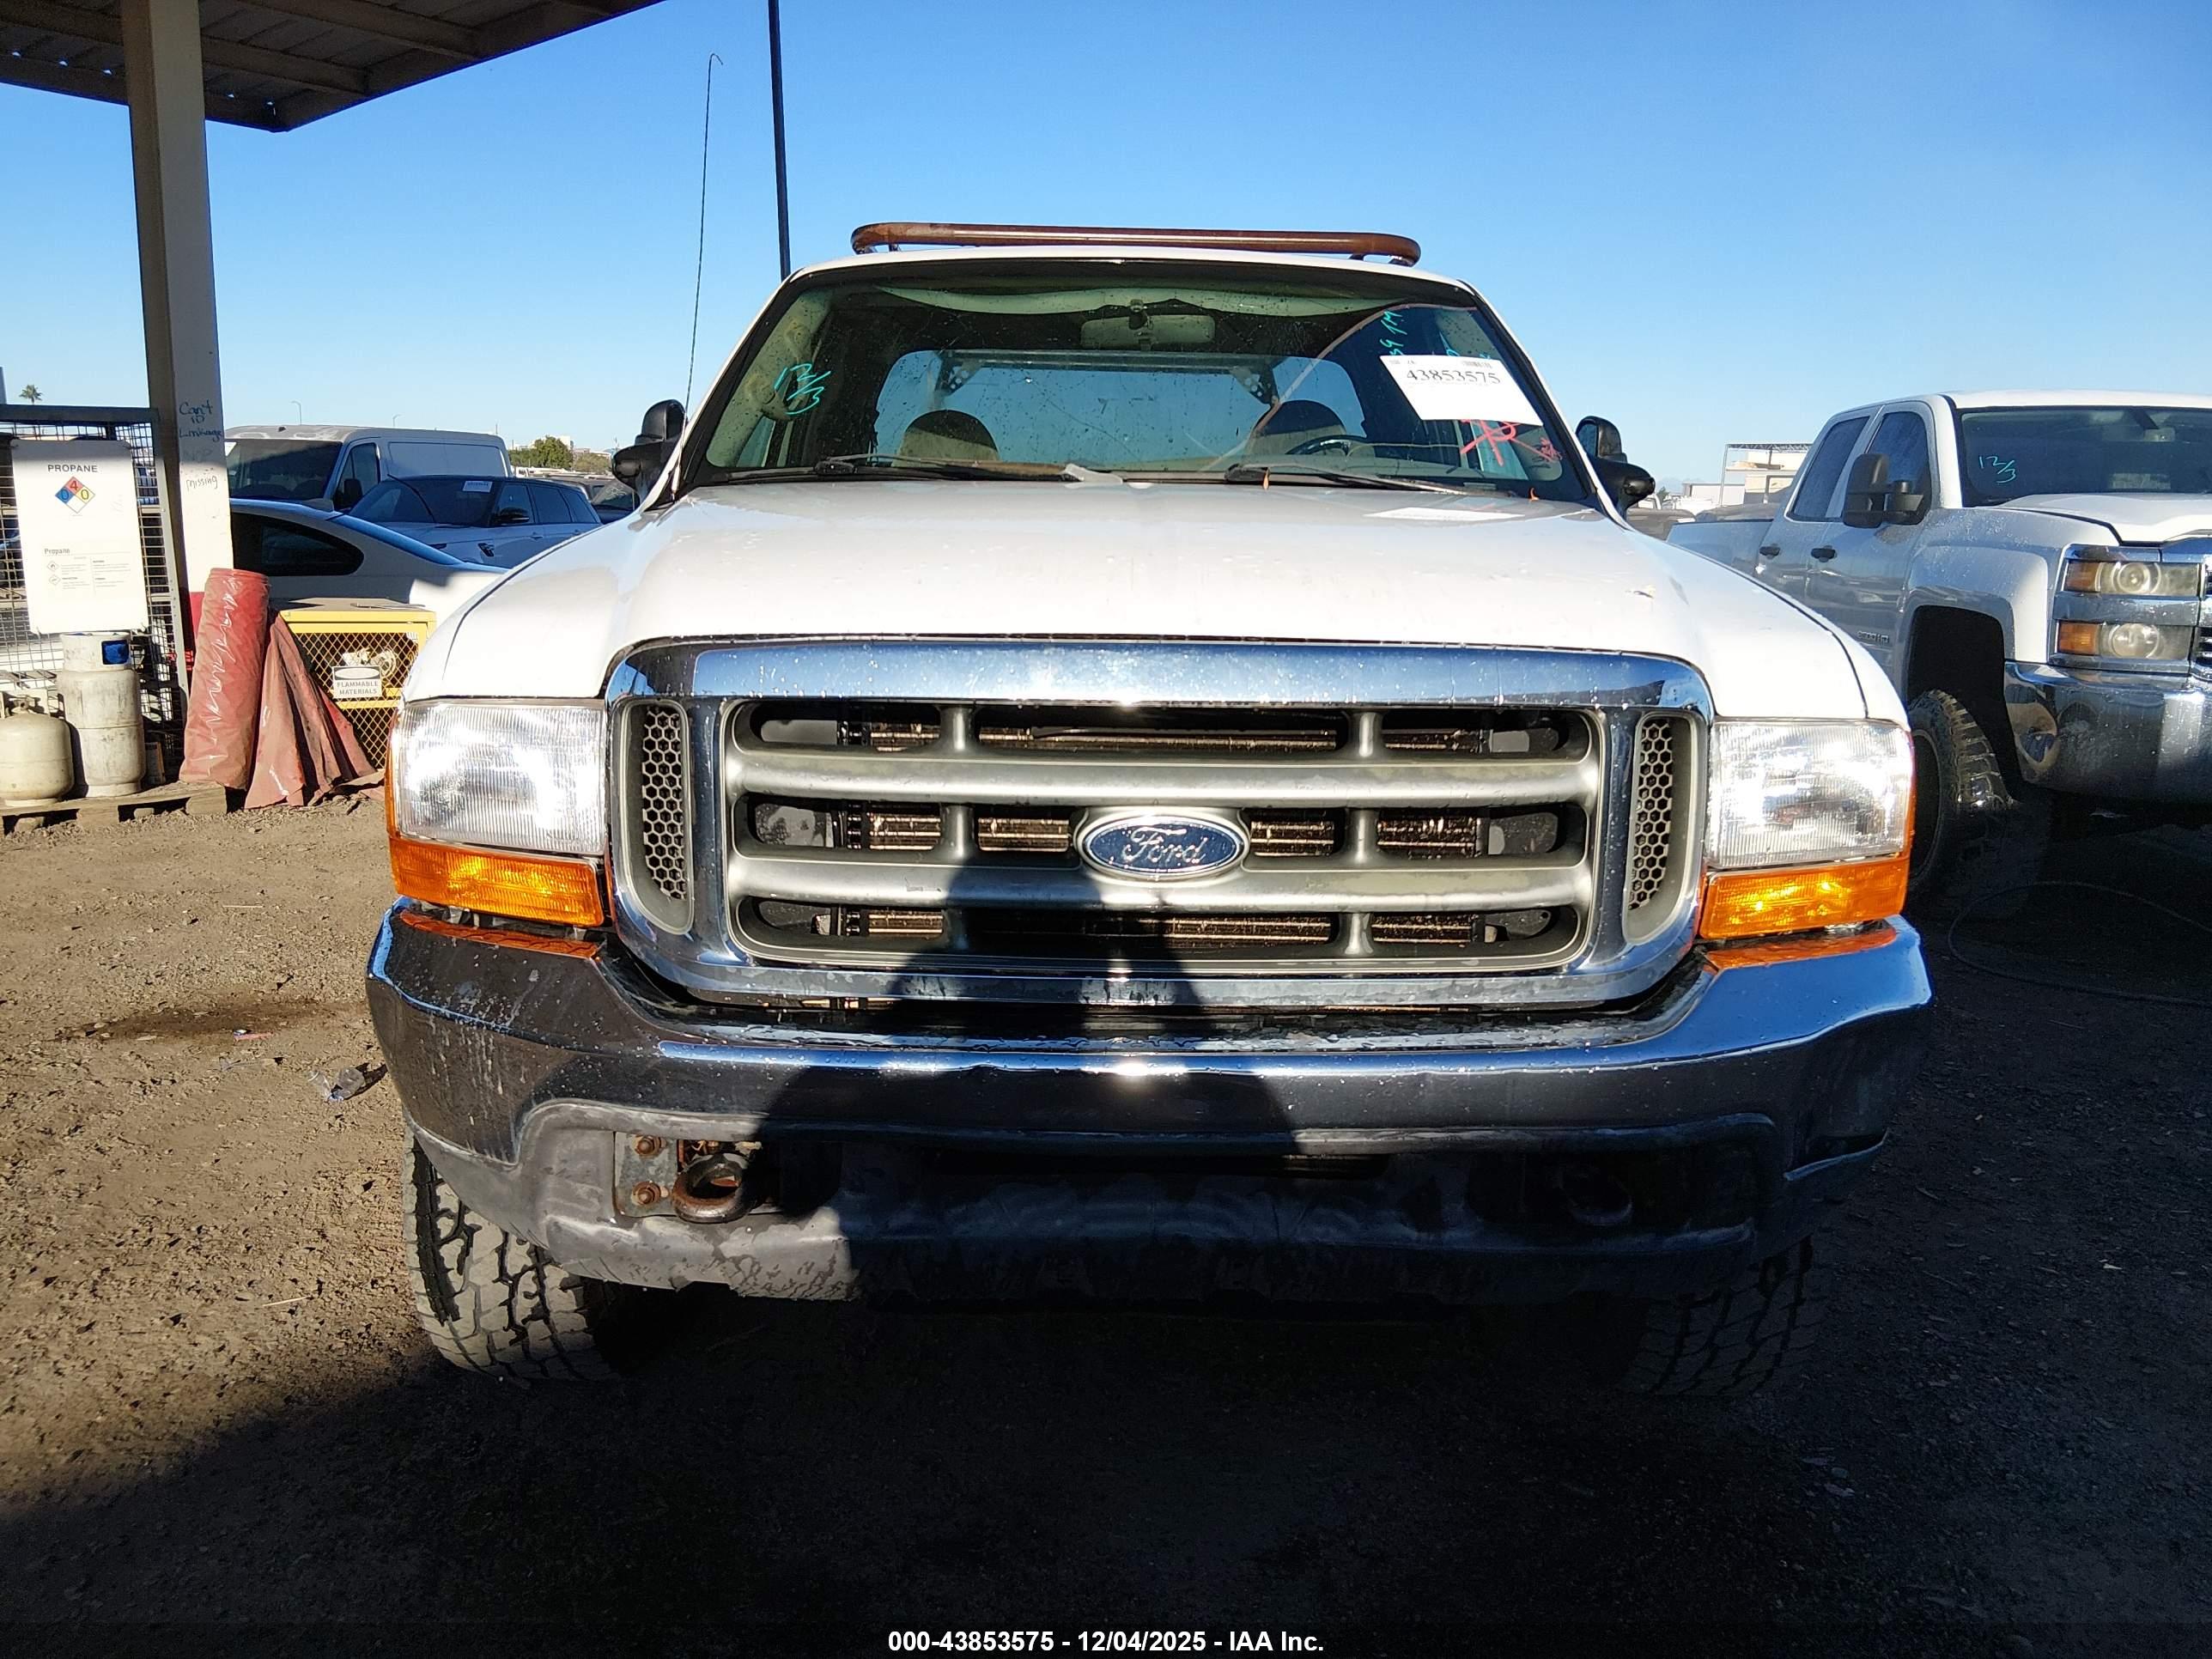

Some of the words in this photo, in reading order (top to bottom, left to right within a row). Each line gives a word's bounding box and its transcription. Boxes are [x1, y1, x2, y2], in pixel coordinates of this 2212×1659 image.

[1407, 369, 1501, 384] 43853575
[774, 363, 831, 416] 12/3
[47, 464, 98, 473] PROPANE
[1978, 455, 2016, 483] 12/3
[70, 480, 79, 491] 4
[60, 489, 70, 501] 0
[81, 489, 89, 501] 0
[1121, 826, 1208, 864] Ford
